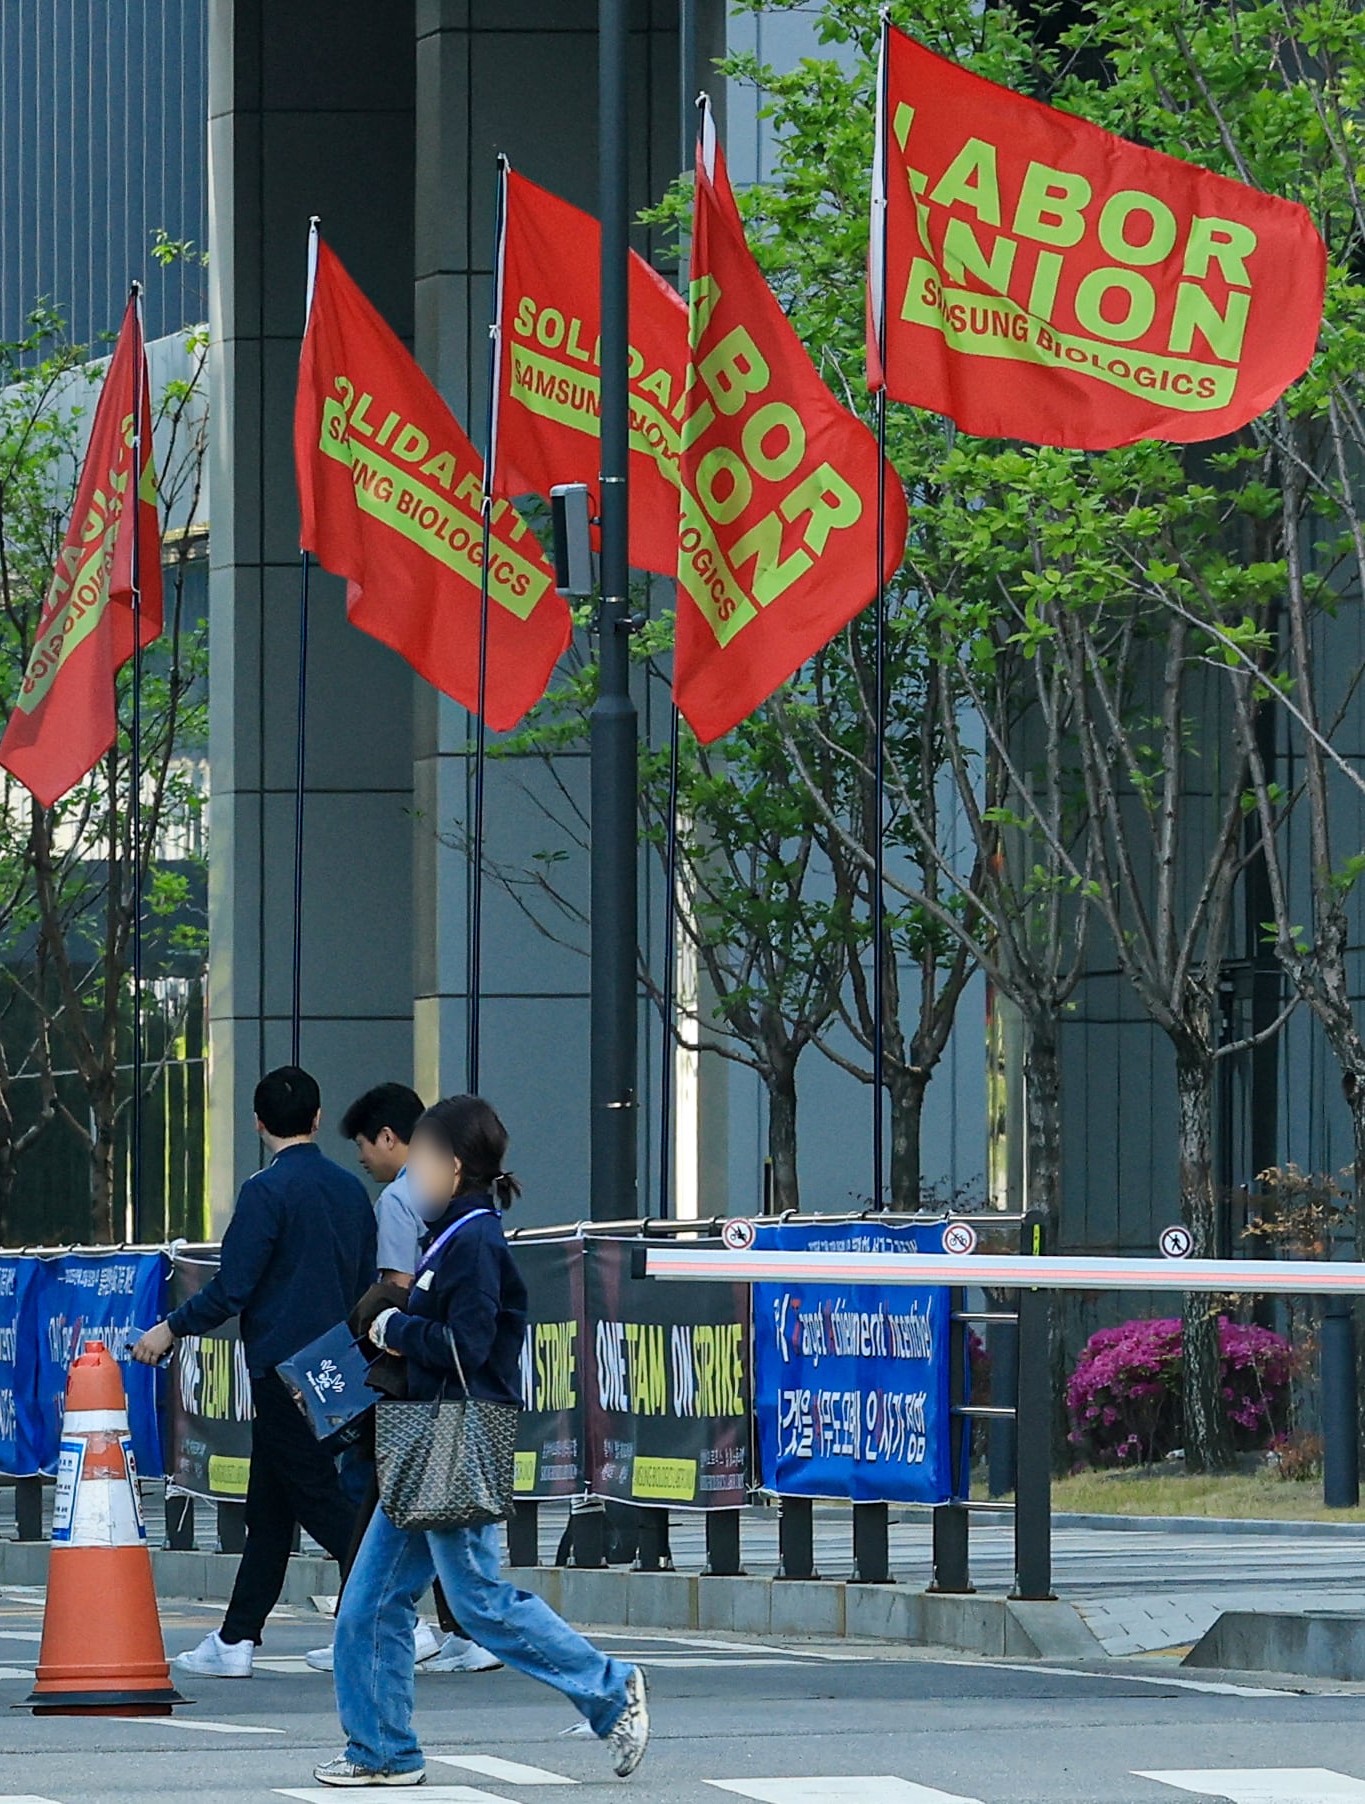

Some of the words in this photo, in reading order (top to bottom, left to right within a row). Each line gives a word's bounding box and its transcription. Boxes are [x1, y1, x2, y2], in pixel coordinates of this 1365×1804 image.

[515, 358, 601, 418] SAMSUN
[920, 276, 1030, 343] SSUNG
[1036, 326, 1217, 400] BIOLOGICS
[689, 274, 863, 558] ABOR
[397, 480, 531, 597] BIOLOGICS
[535, 1320, 577, 1412] STRIKE
[596, 1320, 628, 1412] ONE
[671, 1325, 694, 1418] ON
